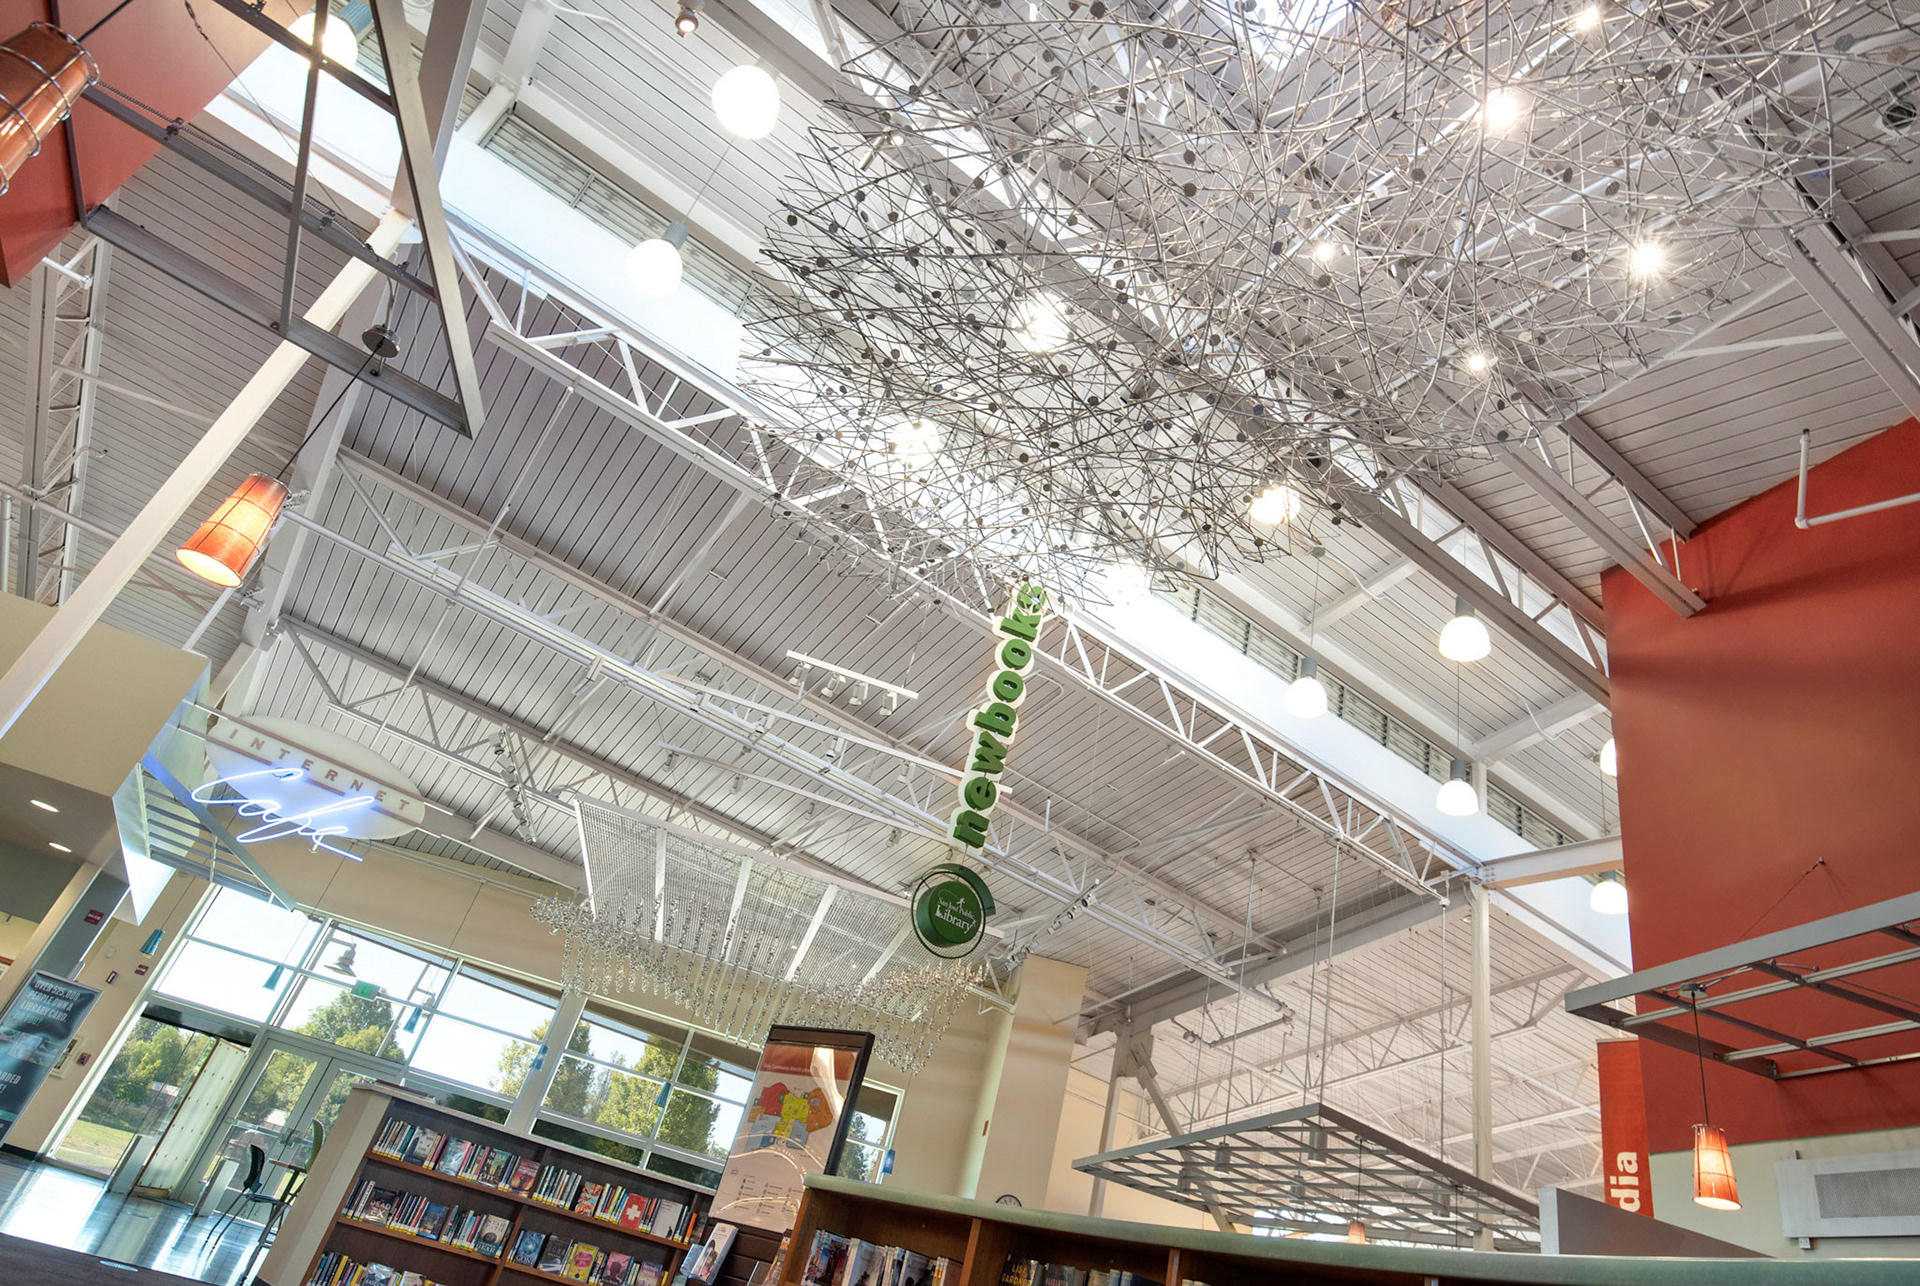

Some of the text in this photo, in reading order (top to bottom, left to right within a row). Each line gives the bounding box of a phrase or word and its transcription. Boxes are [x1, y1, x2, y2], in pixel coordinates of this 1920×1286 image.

[229, 729, 410, 811] INTERNET
[953, 730, 1008, 849] new
[935, 904, 974, 934] Library
[27, 990, 54, 1004] PEOPLE
[34, 980, 53, 993] OVER
[20, 1000, 51, 1016] LIBRARY
